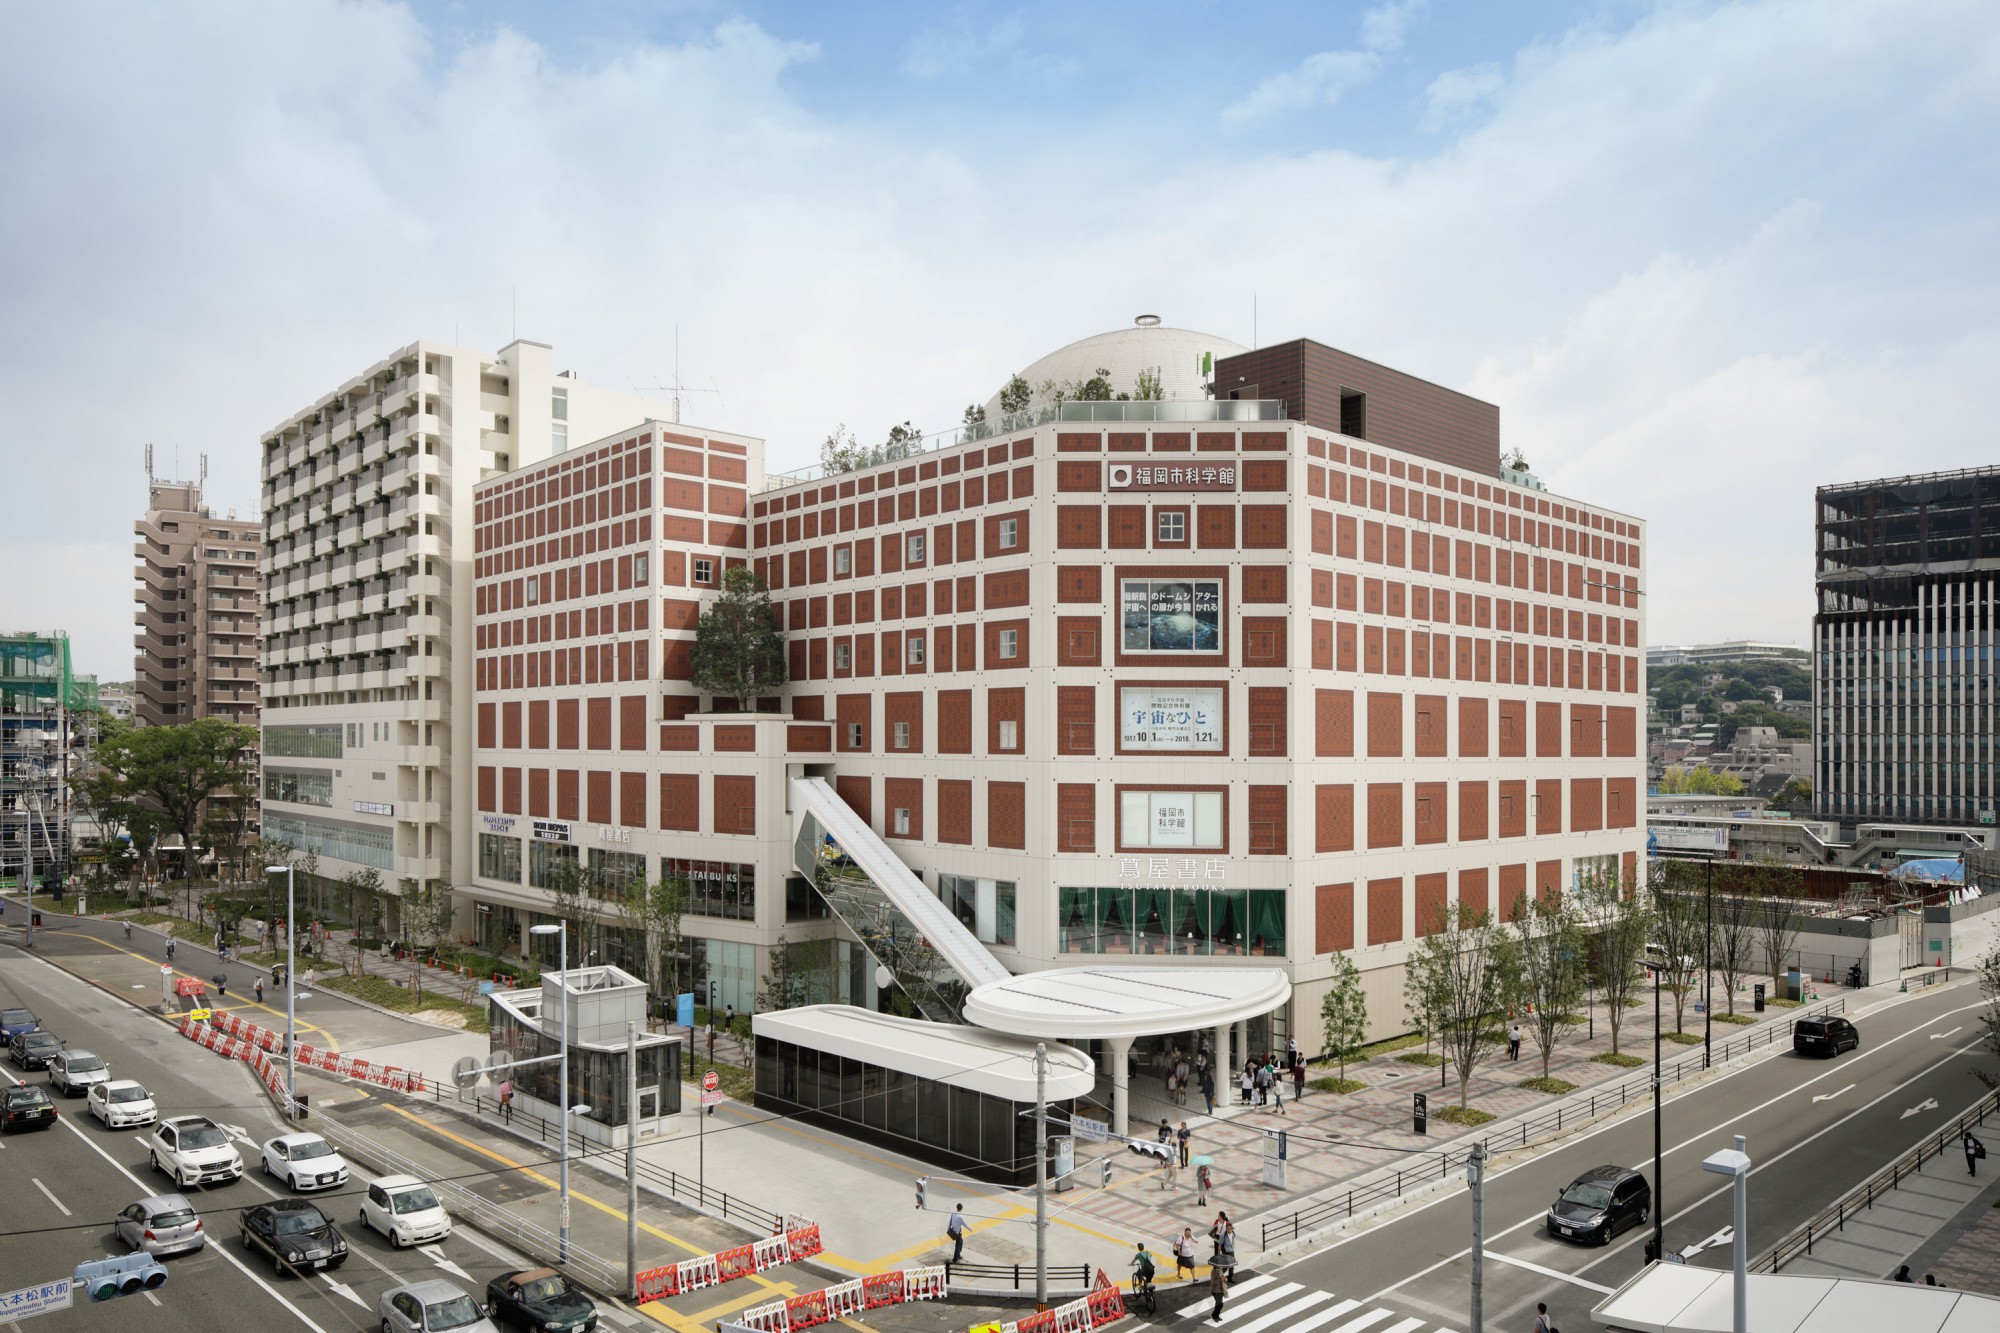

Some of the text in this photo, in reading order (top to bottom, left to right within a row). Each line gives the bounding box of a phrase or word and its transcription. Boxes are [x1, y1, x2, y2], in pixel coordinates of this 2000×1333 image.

[1136, 467, 1235, 485] 福岡市科学館
[1132, 710, 1206, 725] 宇宙なひと
[1158, 807, 1185, 817] 福岡市
[1158, 818, 1185, 828] 科学館
[1119, 857, 1226, 879] 蔦屋書店
[688, 870, 737, 883] STABUKS
[1120, 882, 1225, 891] TSUTAYA BOOKS
[0, 1282, 68, 1308] 六本松駅前
[44, 1295, 66, 1305] Station
[18, 1306, 47, 1317] Intersection
